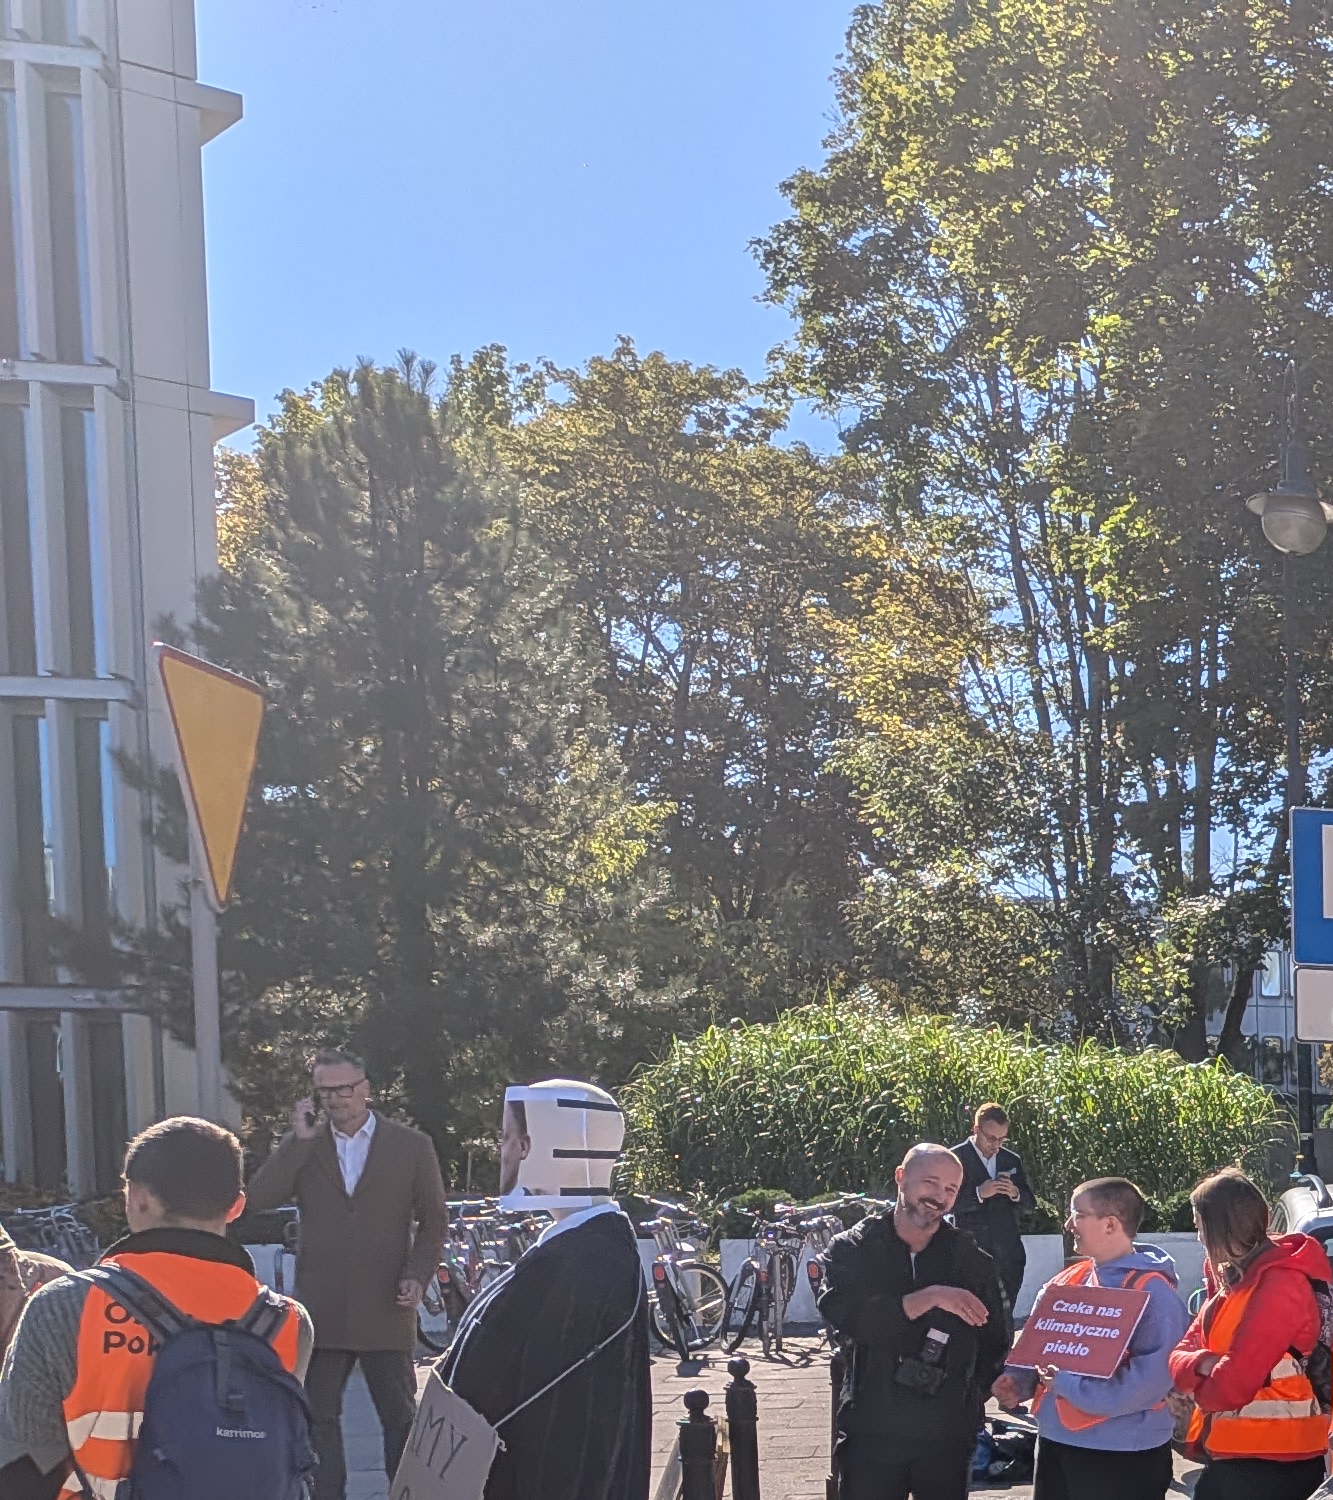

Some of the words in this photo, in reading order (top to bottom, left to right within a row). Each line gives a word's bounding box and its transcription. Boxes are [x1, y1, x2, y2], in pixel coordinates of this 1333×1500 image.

[1052, 1300, 1094, 1315] Czeka
[1095, 1306, 1123, 1318] nas
[1034, 1318, 1120, 1338] klimatyczne
[1042, 1340, 1090, 1356] piekło
